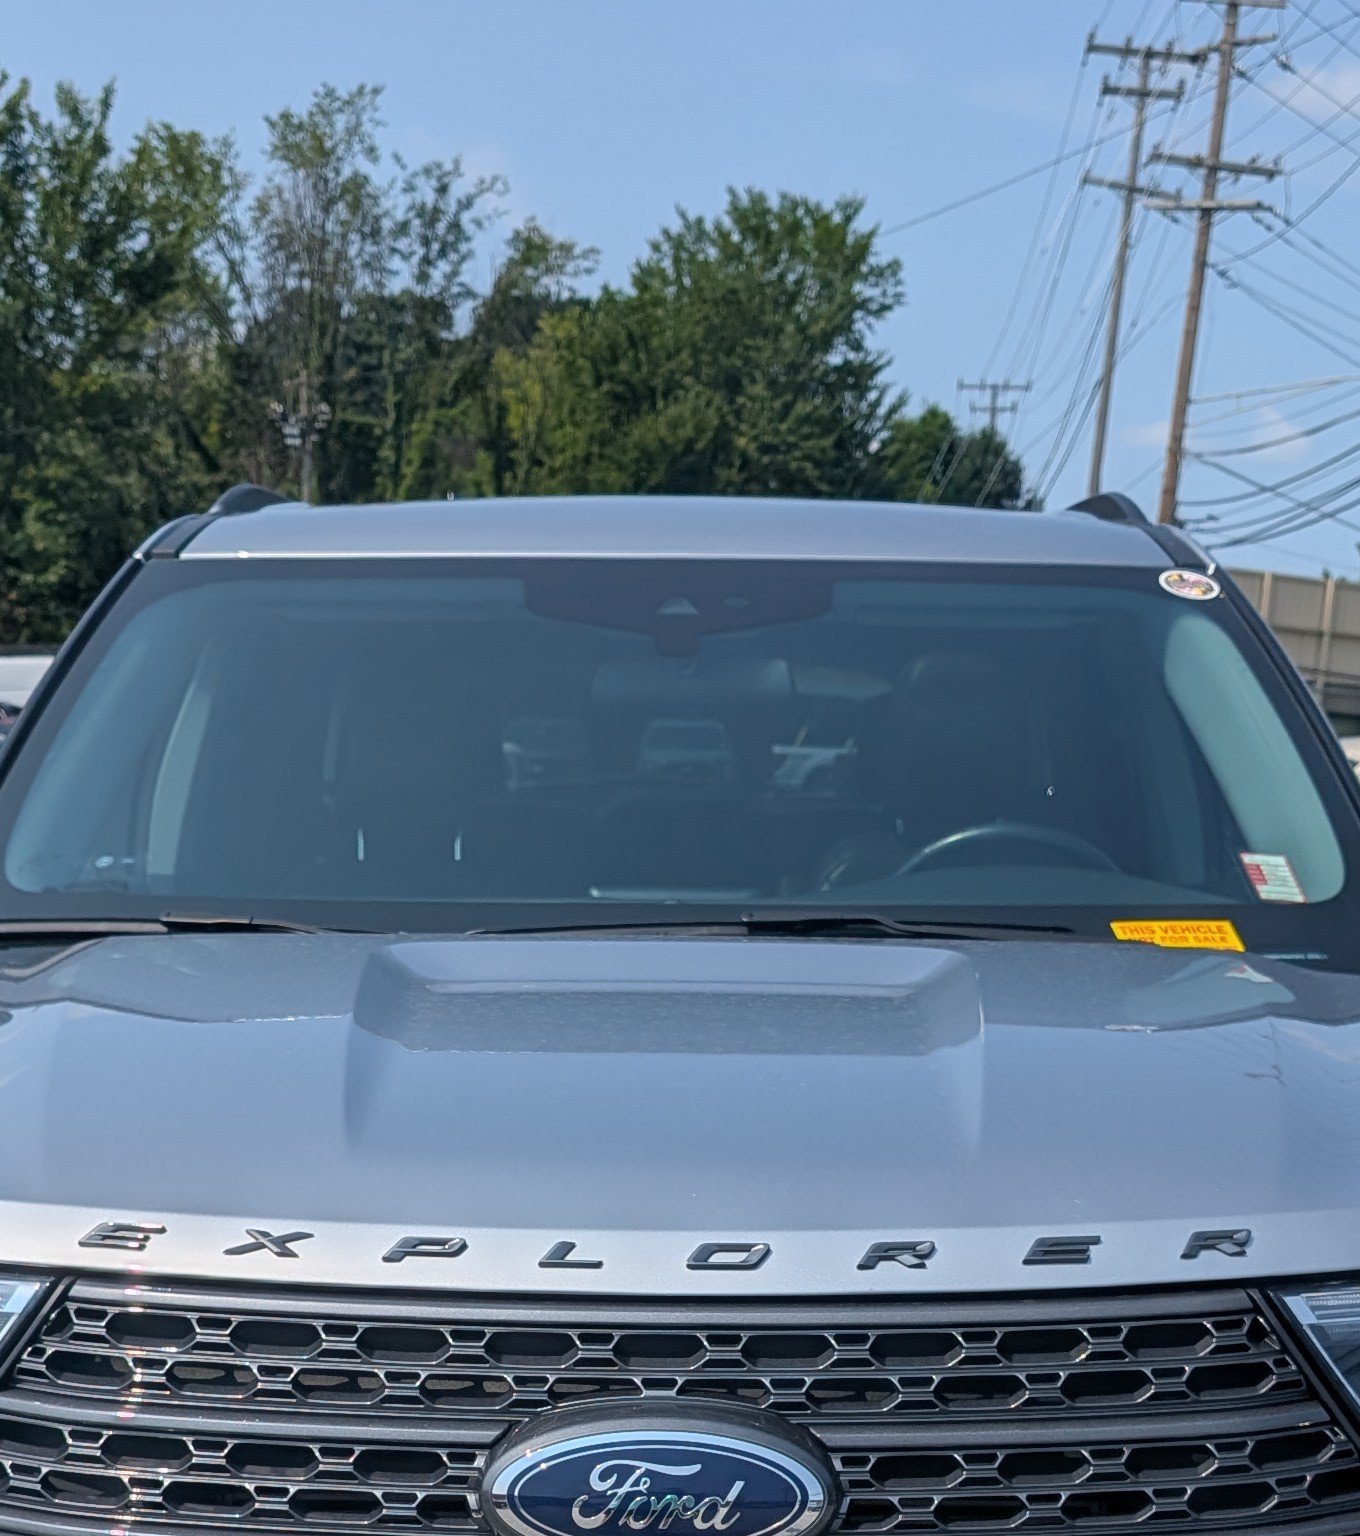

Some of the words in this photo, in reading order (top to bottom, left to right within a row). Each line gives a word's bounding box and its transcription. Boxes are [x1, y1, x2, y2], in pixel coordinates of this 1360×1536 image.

[1120, 926, 1155, 935] THIS
[1158, 925, 1228, 935] VEHICLE
[77, 1221, 1254, 1271] EXPLORER
[571, 1458, 746, 1531] Ford
